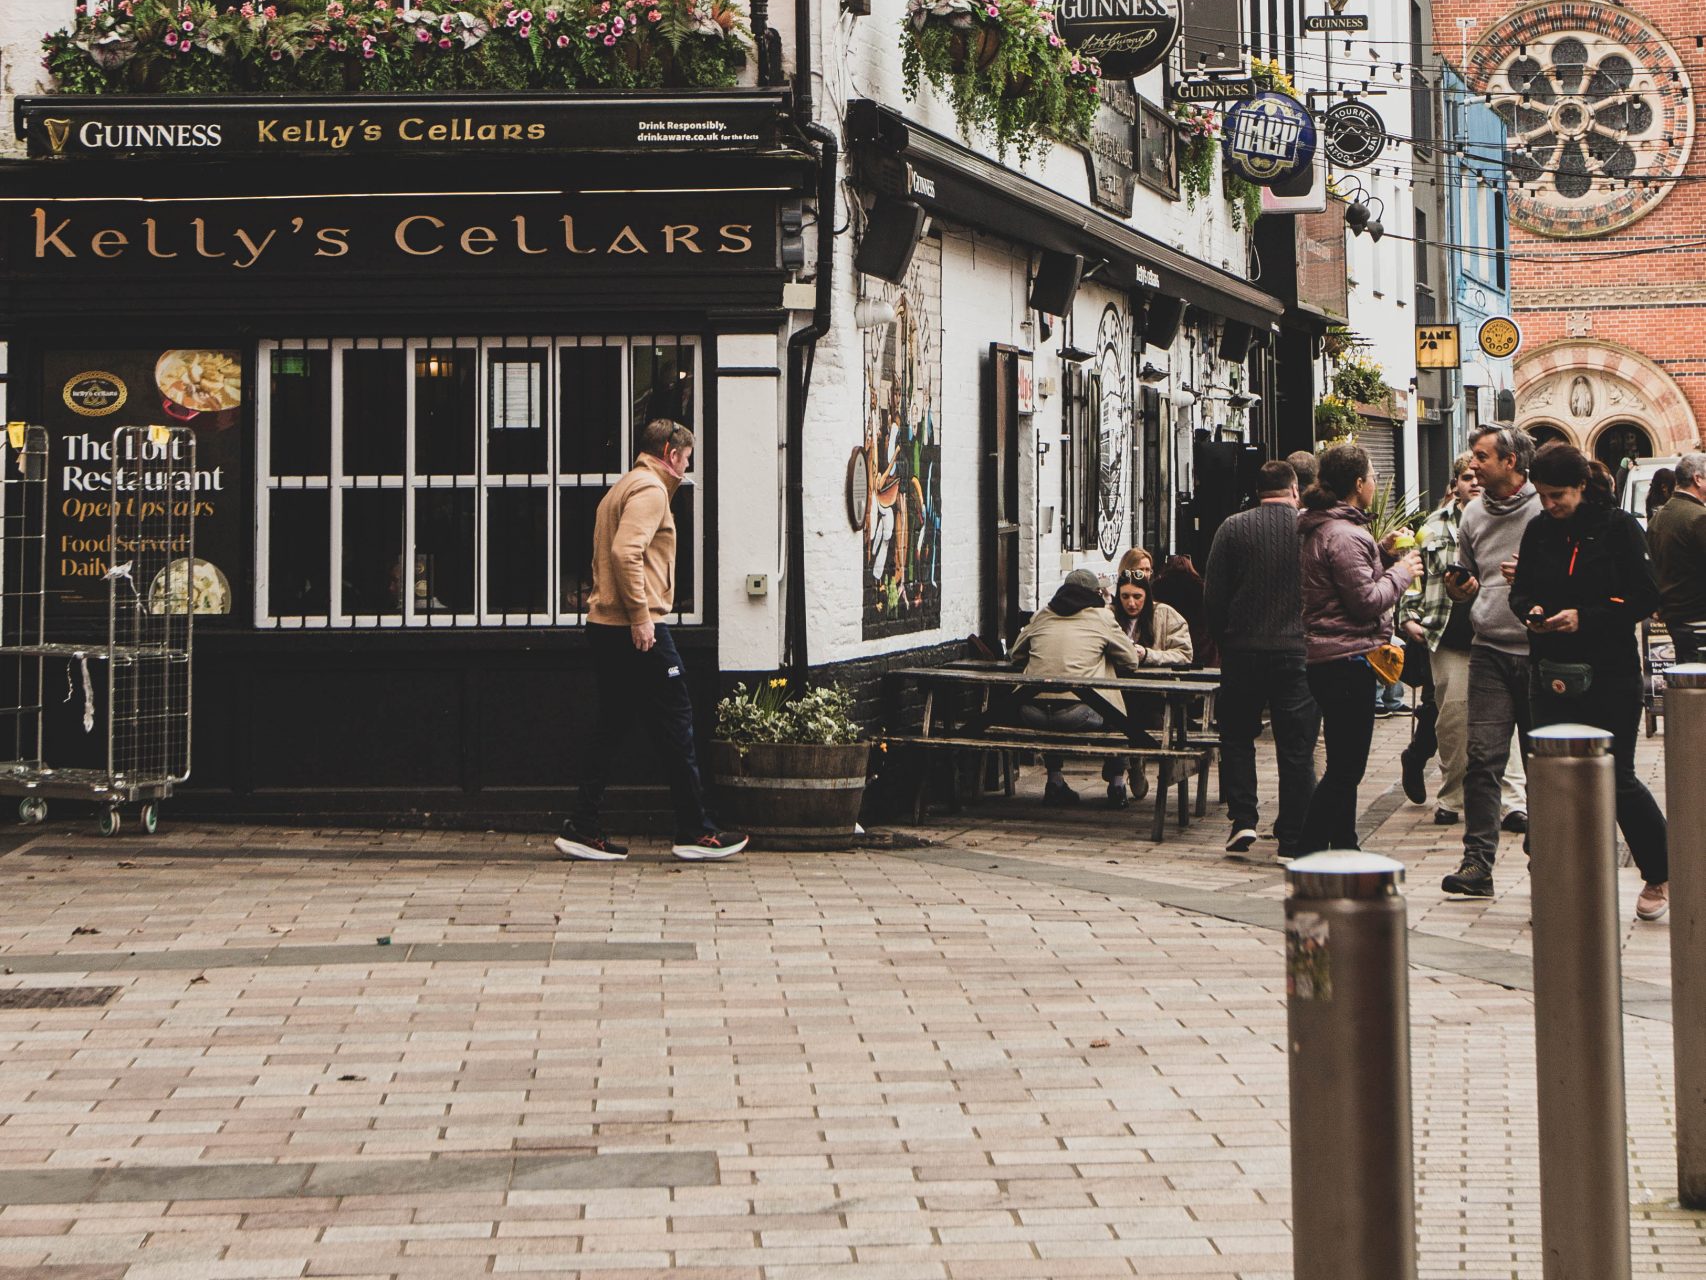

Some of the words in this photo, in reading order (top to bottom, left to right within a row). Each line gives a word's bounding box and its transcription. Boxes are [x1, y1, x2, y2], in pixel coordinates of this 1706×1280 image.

[1309, 17, 1364, 28] GUINNESS
[1177, 83, 1249, 98] GUINNESS
[79, 121, 222, 148] GUINNESS
[257, 119, 382, 149] Kelly's
[398, 117, 546, 141] Cellars
[637, 132, 719, 141] drinkaware.co.uk
[638, 121, 665, 130] Drink
[666, 121, 727, 131] Responsibly.
[1235, 113, 1297, 157] HARP
[31, 207, 350, 268] Kelly's
[394, 214, 752, 256] Cellars
[1420, 331, 1452, 340] BANK
[1420, 340, 1438, 350] SQ
[62, 433, 114, 461] The
[63, 465, 225, 492] Restaurant
[62, 497, 121, 523] Open
[126, 497, 215, 522] Upsars
[61, 534, 112, 553] Food
